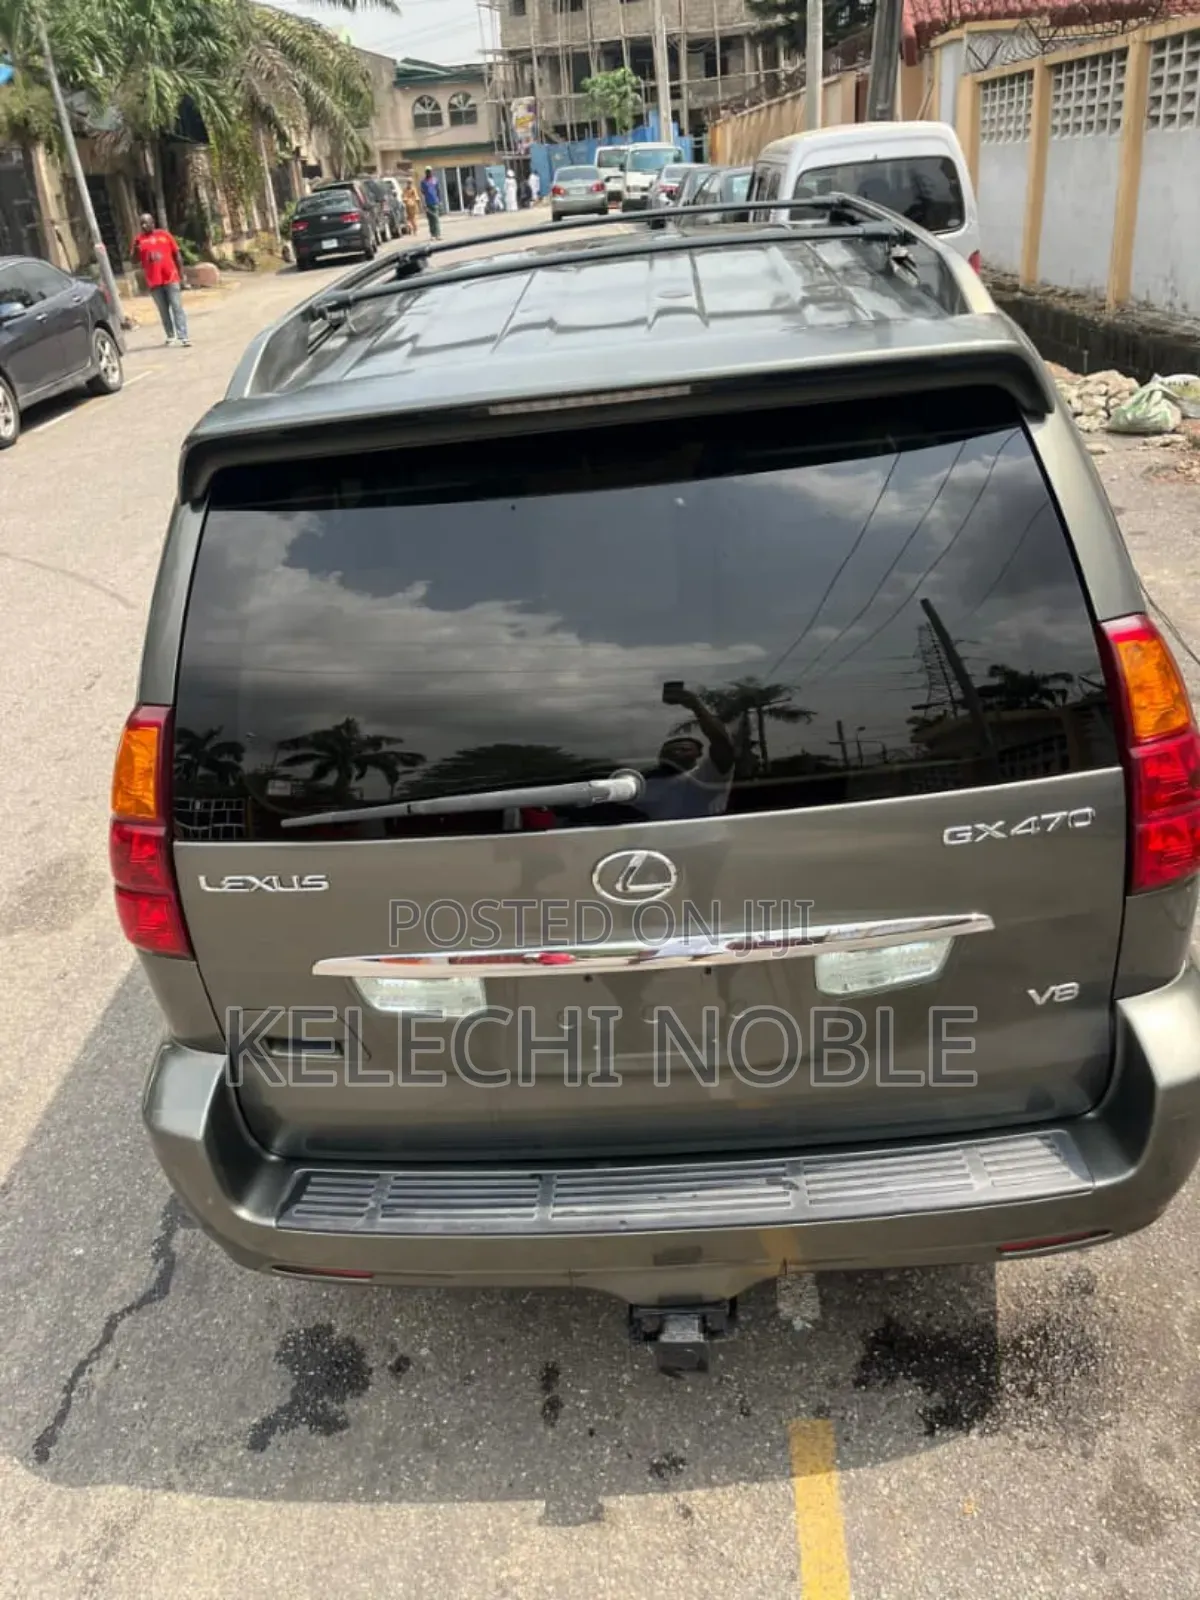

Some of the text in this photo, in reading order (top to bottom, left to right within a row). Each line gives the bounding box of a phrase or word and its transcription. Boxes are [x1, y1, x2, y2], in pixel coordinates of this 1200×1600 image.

[943, 807, 1095, 845] GX470
[198, 874, 330, 893] LEXUS
[1027, 981, 1080, 1005] V8
